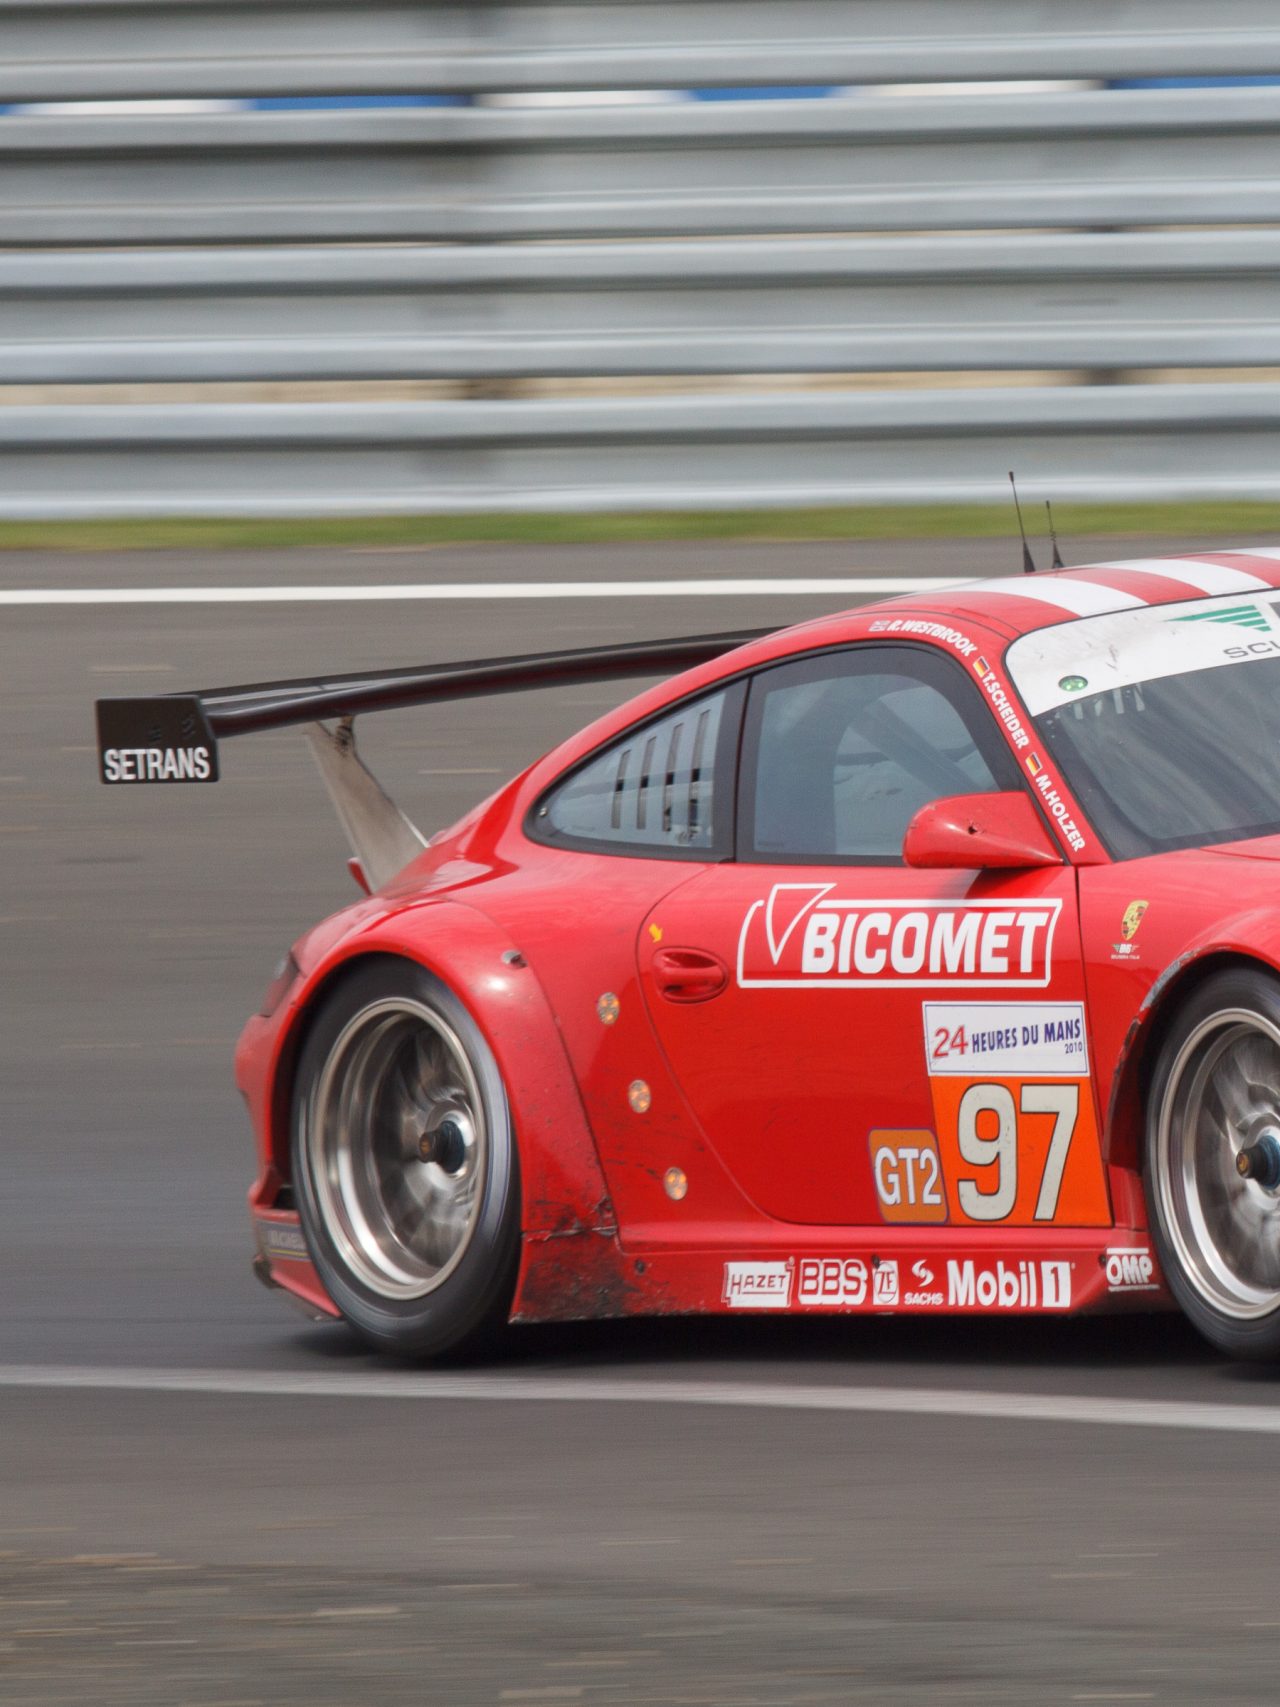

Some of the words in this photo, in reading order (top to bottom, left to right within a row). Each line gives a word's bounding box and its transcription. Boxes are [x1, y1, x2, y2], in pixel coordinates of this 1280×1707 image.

[982, 673, 1030, 749] T.SCHEIDER
[104, 747, 210, 781] SETRANS
[1035, 774, 1086, 852] M.HOLZER
[801, 911, 1050, 975] BICOMET
[931, 1024, 969, 1059] 24
[971, 1027, 1018, 1054] HEURES
[1022, 1024, 1040, 1046] DU
[1043, 1018, 1081, 1043] MANS
[1064, 1041, 1084, 1055] 2010
[956, 1082, 1081, 1222] 97
[873, 1147, 943, 1206] GT2
[730, 1273, 787, 1295] HAZET
[799, 1259, 868, 1305] BBS
[946, 1259, 1037, 1308] Mobil
[1106, 1255, 1153, 1285] OMP
[904, 1292, 944, 1306] SACHS
